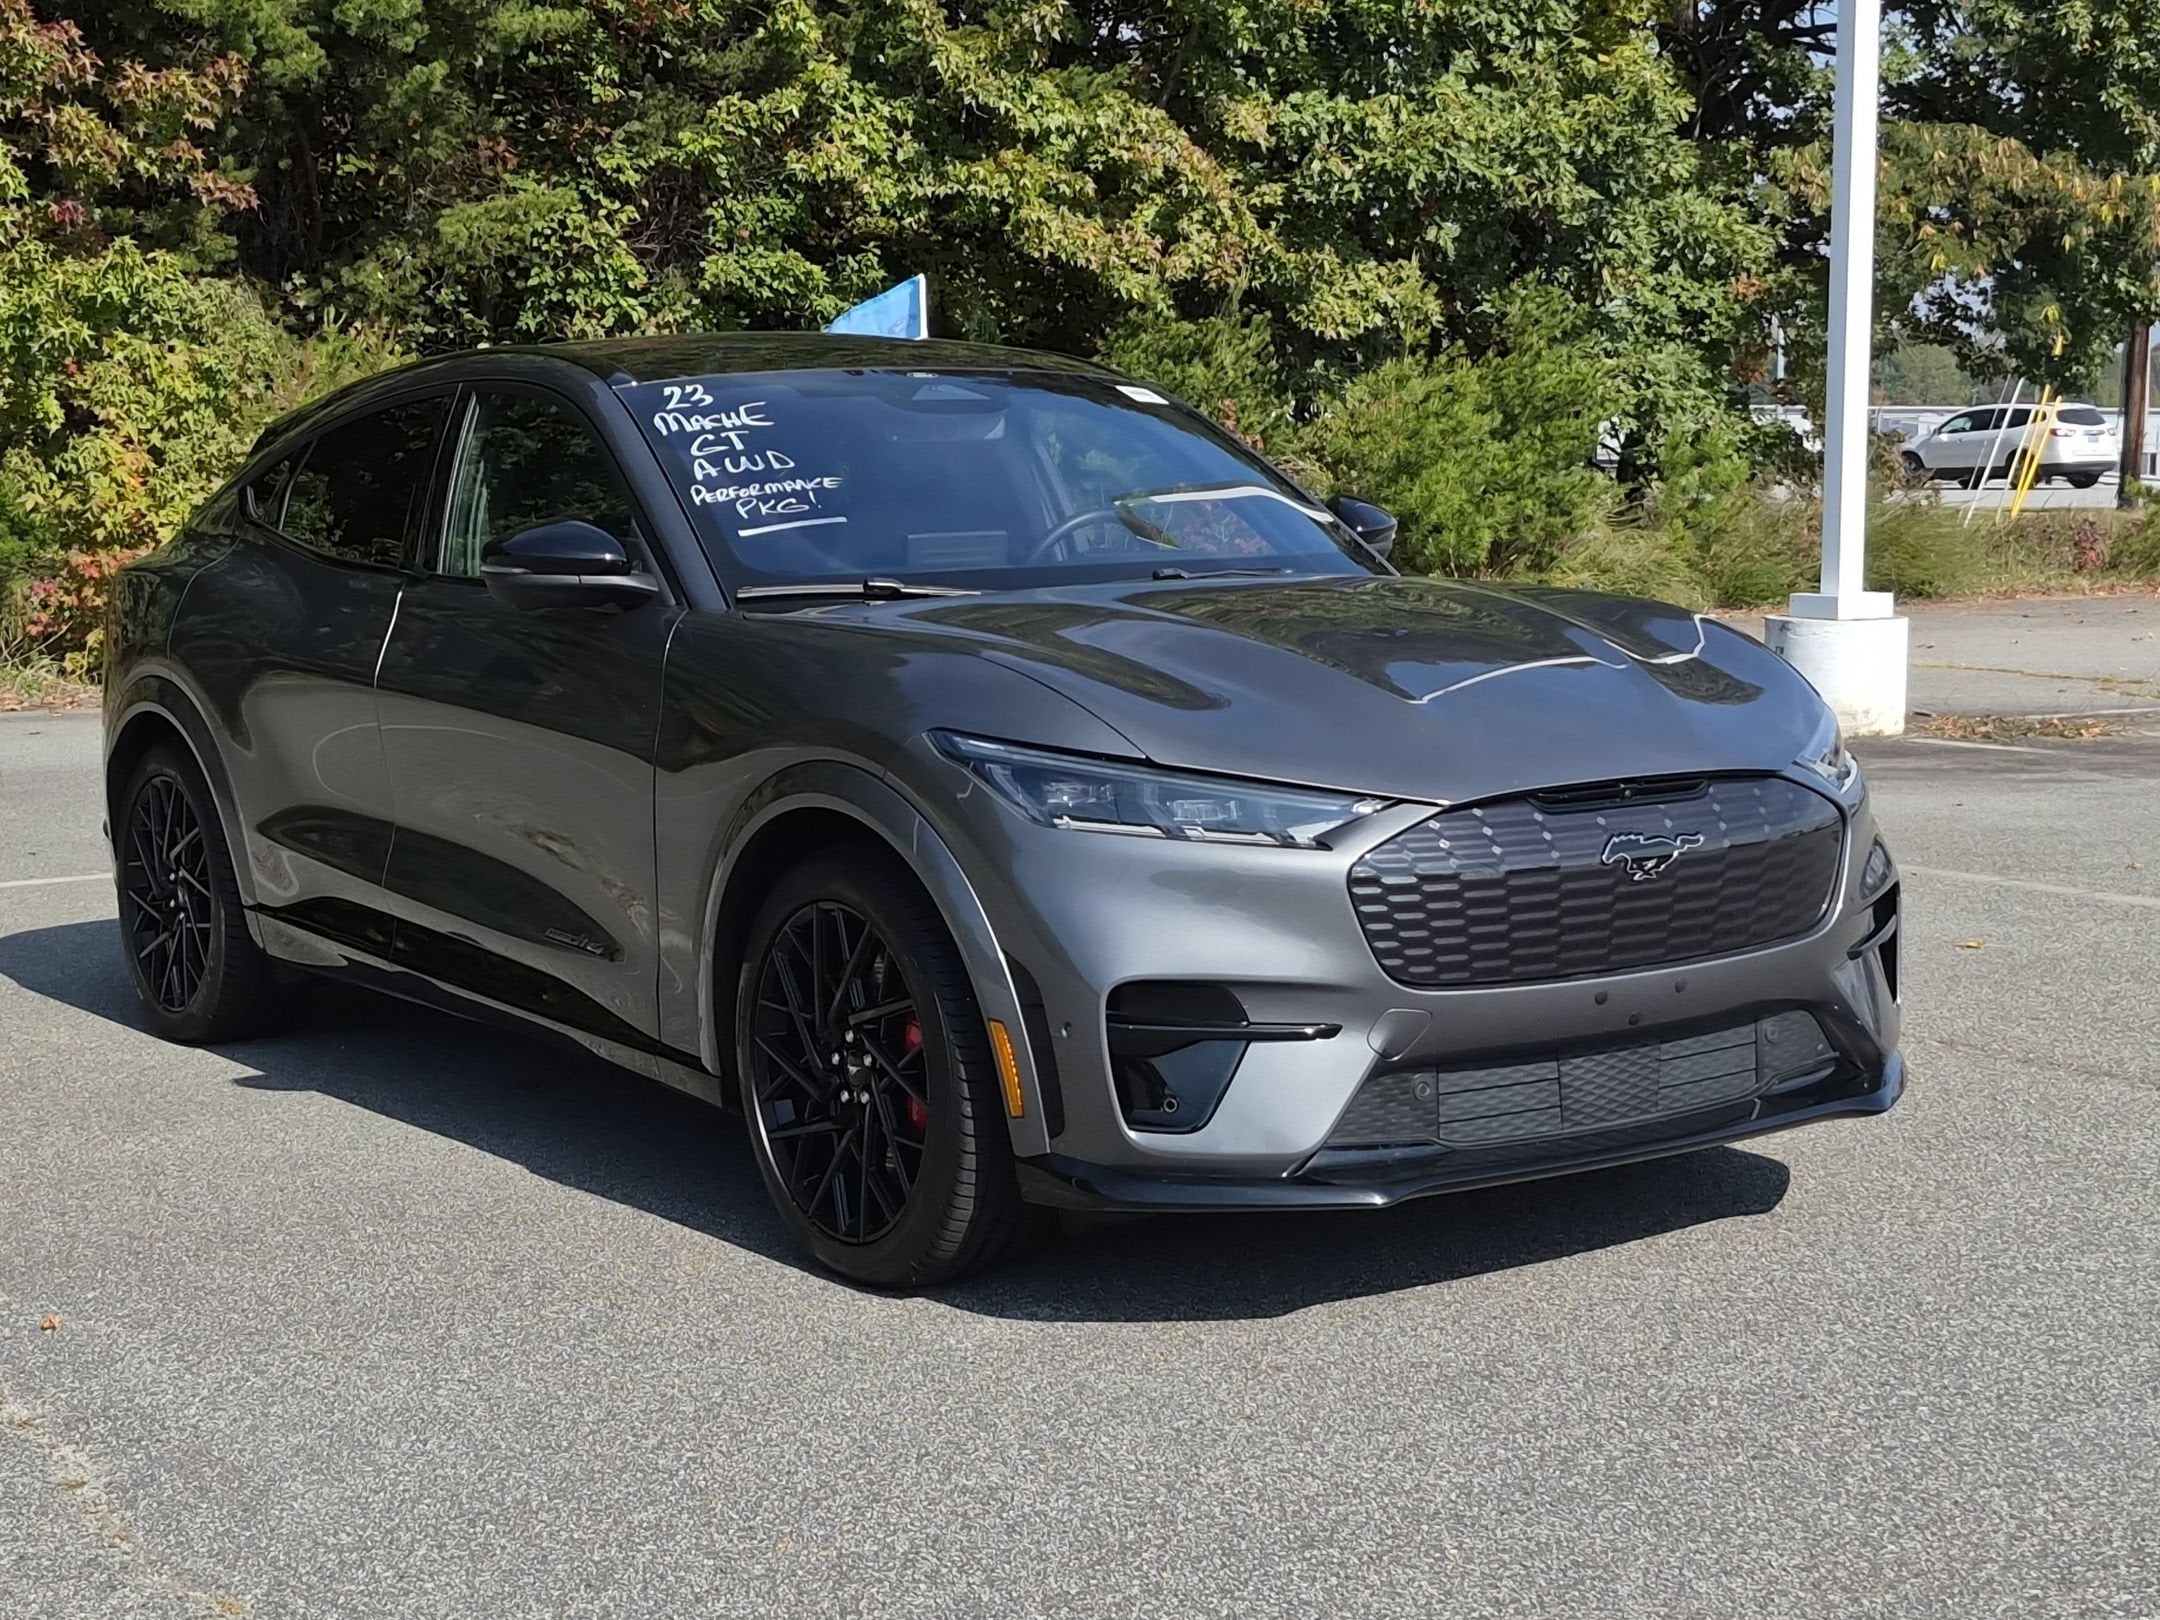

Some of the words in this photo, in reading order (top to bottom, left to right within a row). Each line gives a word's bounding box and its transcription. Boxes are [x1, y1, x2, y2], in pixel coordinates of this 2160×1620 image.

[663, 384, 714, 410] 23
[690, 430, 749, 456] GT
[693, 450, 795, 481] AWD
[690, 477, 843, 506] PERFORMANCE
[735, 491, 822, 519] PKG!
